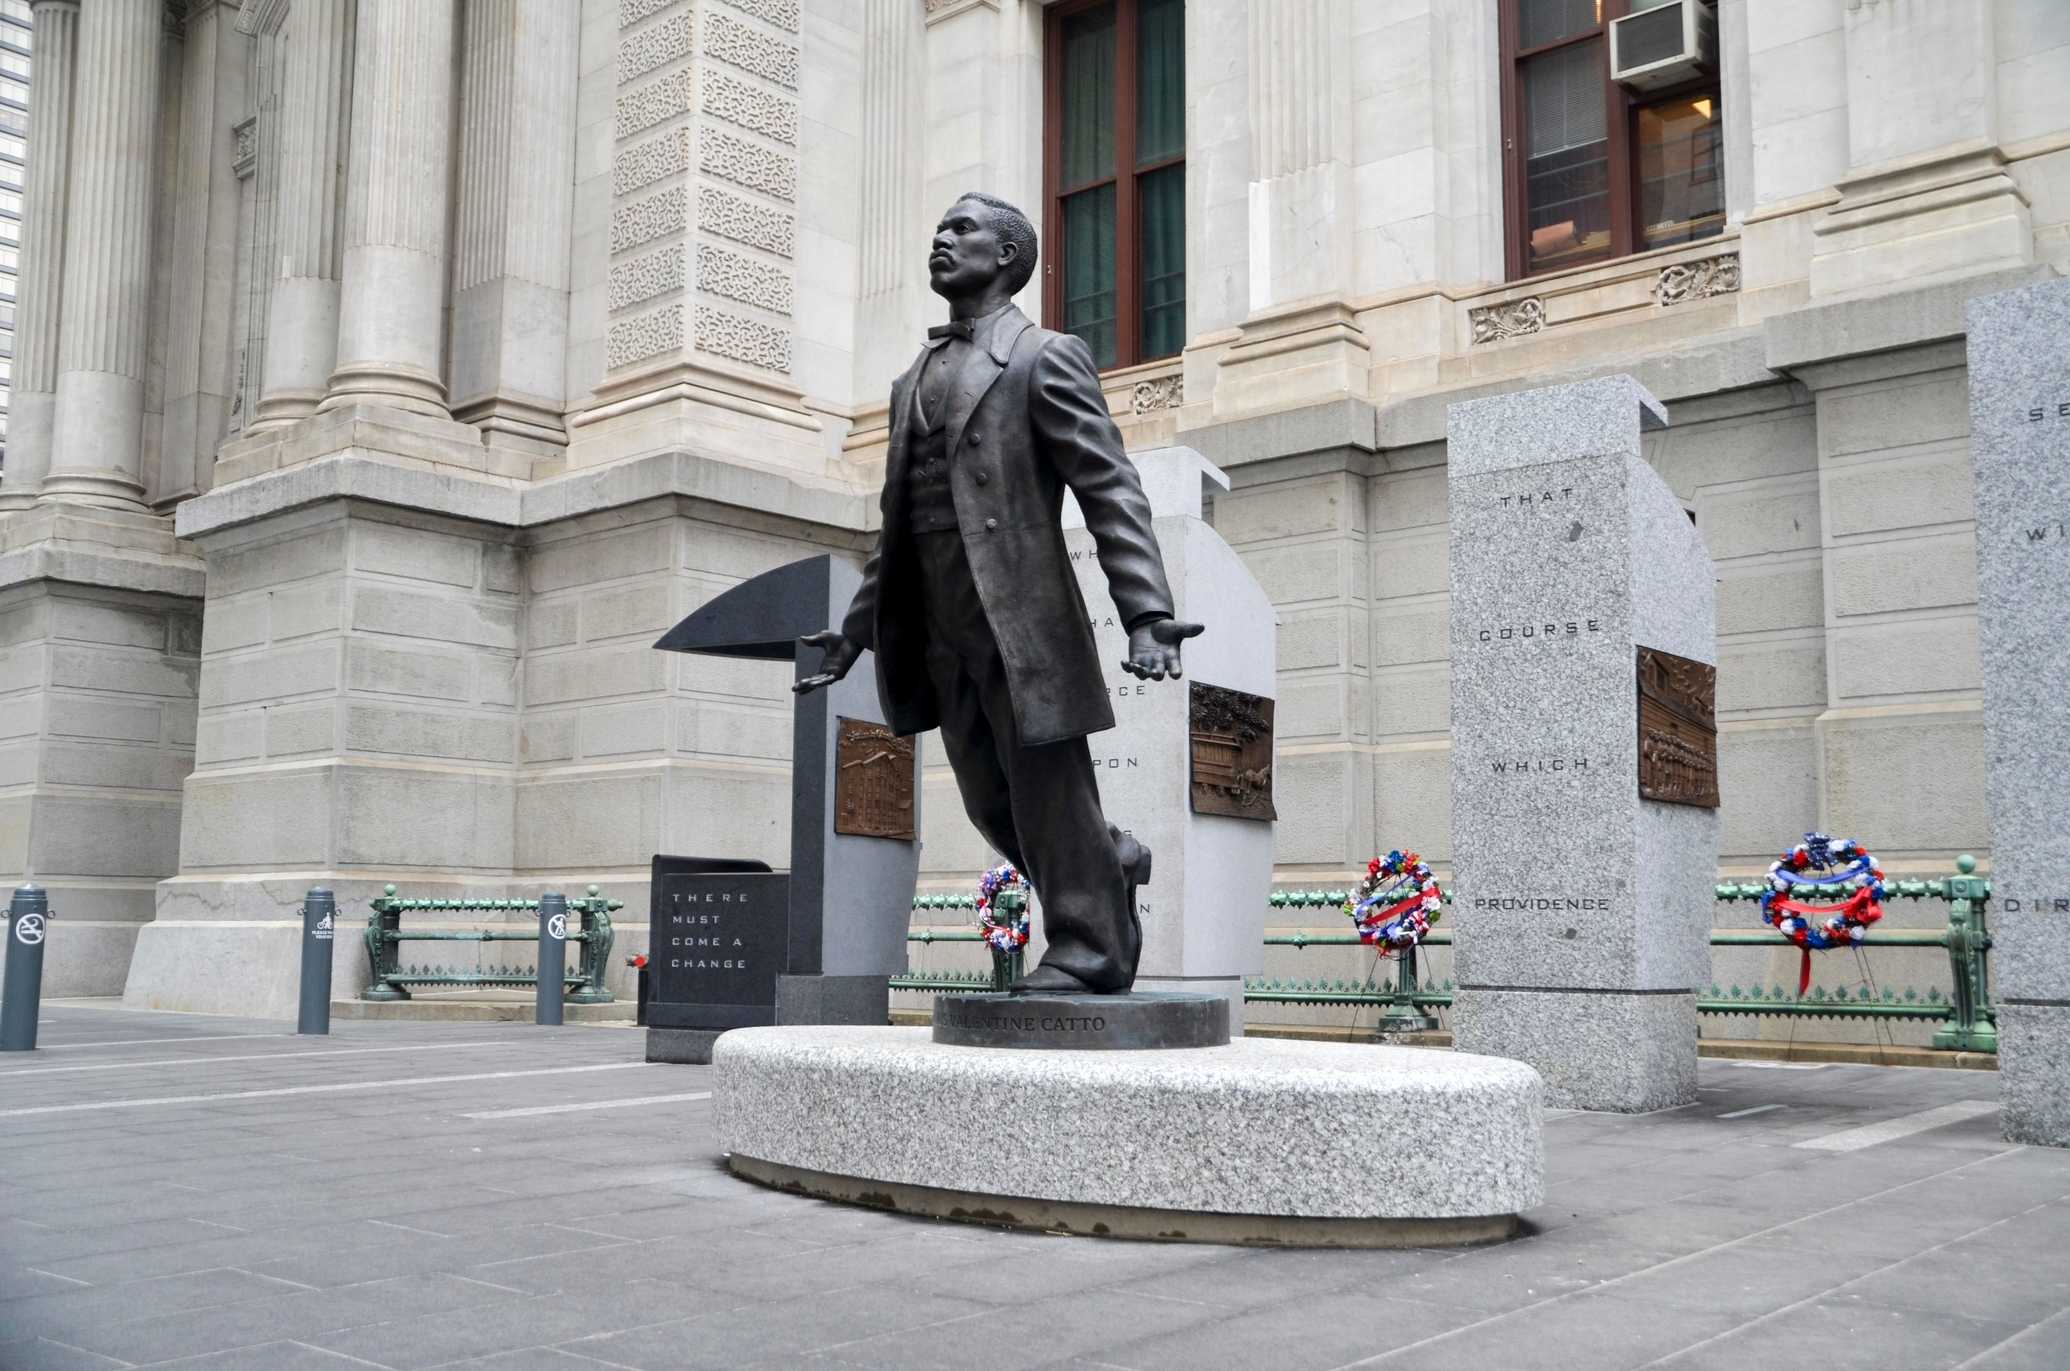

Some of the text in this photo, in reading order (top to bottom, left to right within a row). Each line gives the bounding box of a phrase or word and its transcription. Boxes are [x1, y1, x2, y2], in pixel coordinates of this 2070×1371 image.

[1500, 488, 1572, 508] THAT
[1480, 620, 1599, 641] COURSE
[1492, 758, 1588, 773] WHICH
[672, 893, 748, 902] THERE
[1475, 898, 1609, 911] PROVIDENCE
[672, 915, 720, 924] MUST
[672, 937, 742, 946] COME A
[671, 959, 745, 969] CHANGE
[949, 1015, 1034, 1032] VALENTINE
[1040, 1016, 1106, 1032] CATTO
